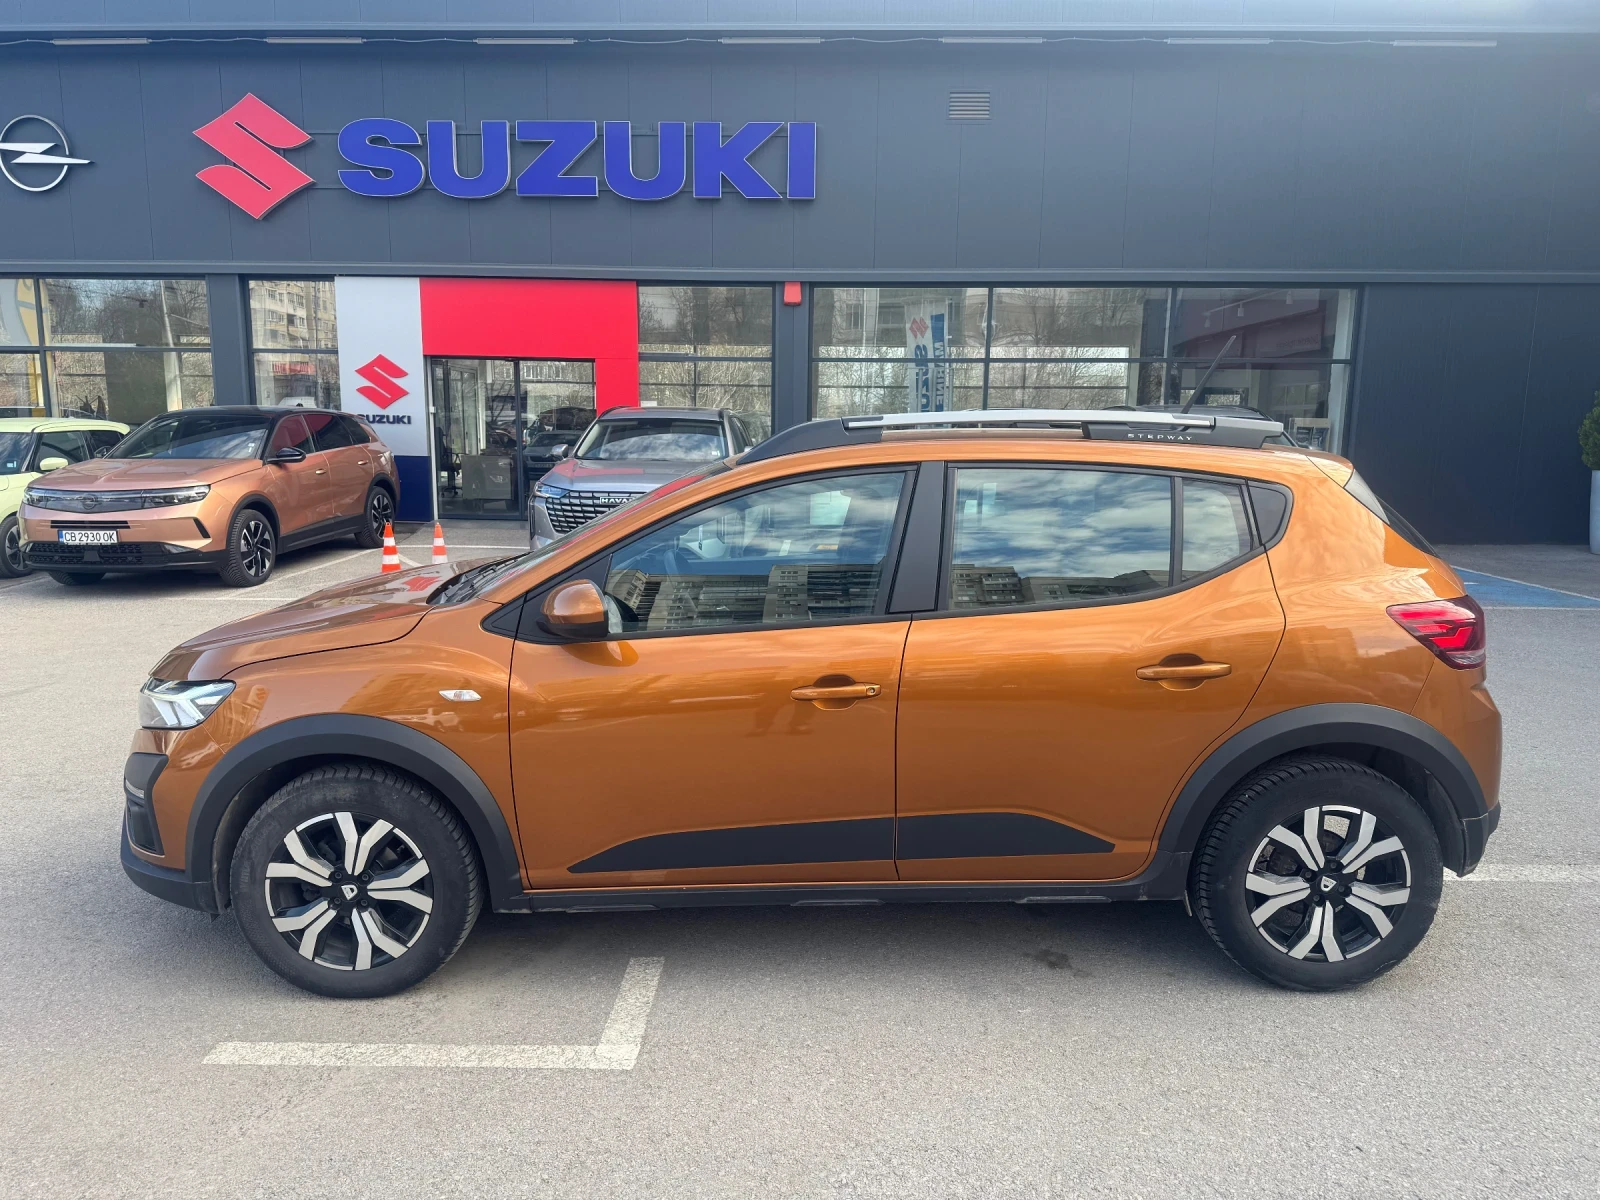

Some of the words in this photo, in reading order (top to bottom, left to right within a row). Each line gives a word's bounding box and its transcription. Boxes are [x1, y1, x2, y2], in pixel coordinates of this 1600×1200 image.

[338, 117, 817, 200] SUZUKI
[1127, 433, 1192, 441] STEPWAY
[64, 532, 76, 542] CB
[78, 532, 101, 542] 2930
[102, 532, 115, 542] OK
